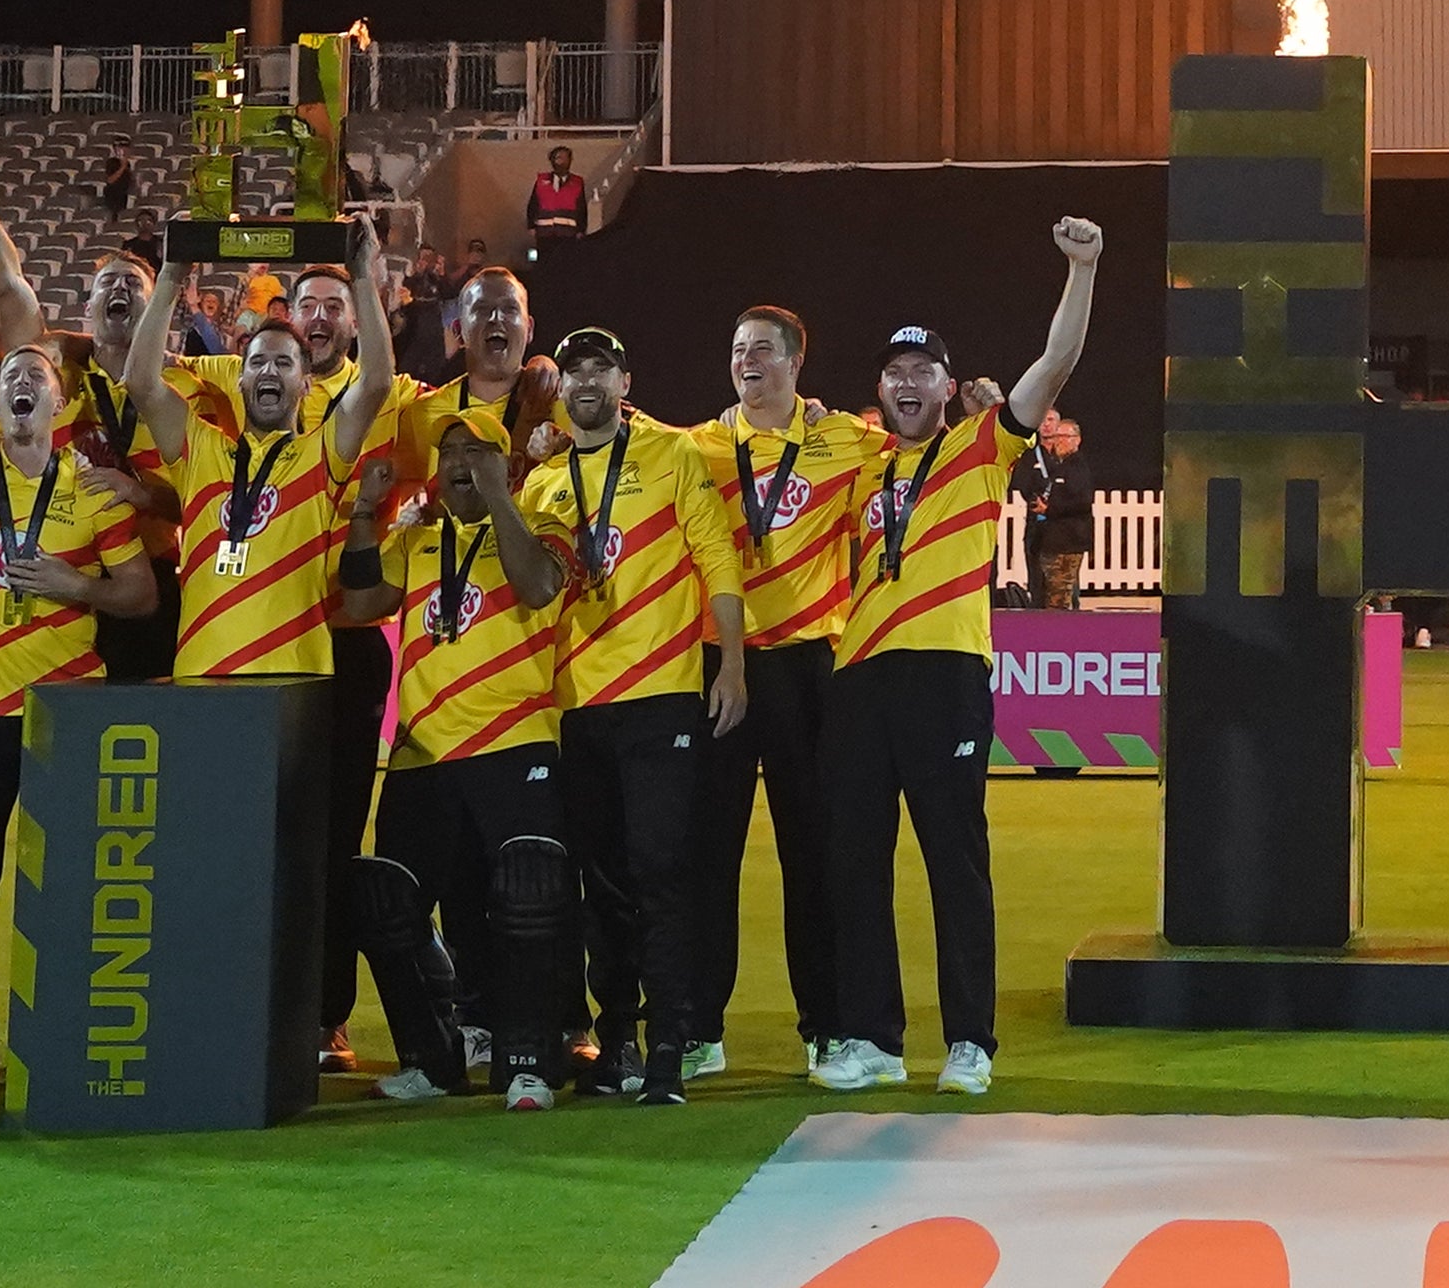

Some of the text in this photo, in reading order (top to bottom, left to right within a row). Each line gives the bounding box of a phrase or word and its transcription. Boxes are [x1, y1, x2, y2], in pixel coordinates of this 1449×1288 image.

[989, 651, 1161, 696] NDRE
[87, 724, 160, 1096] THE HUNDRED
